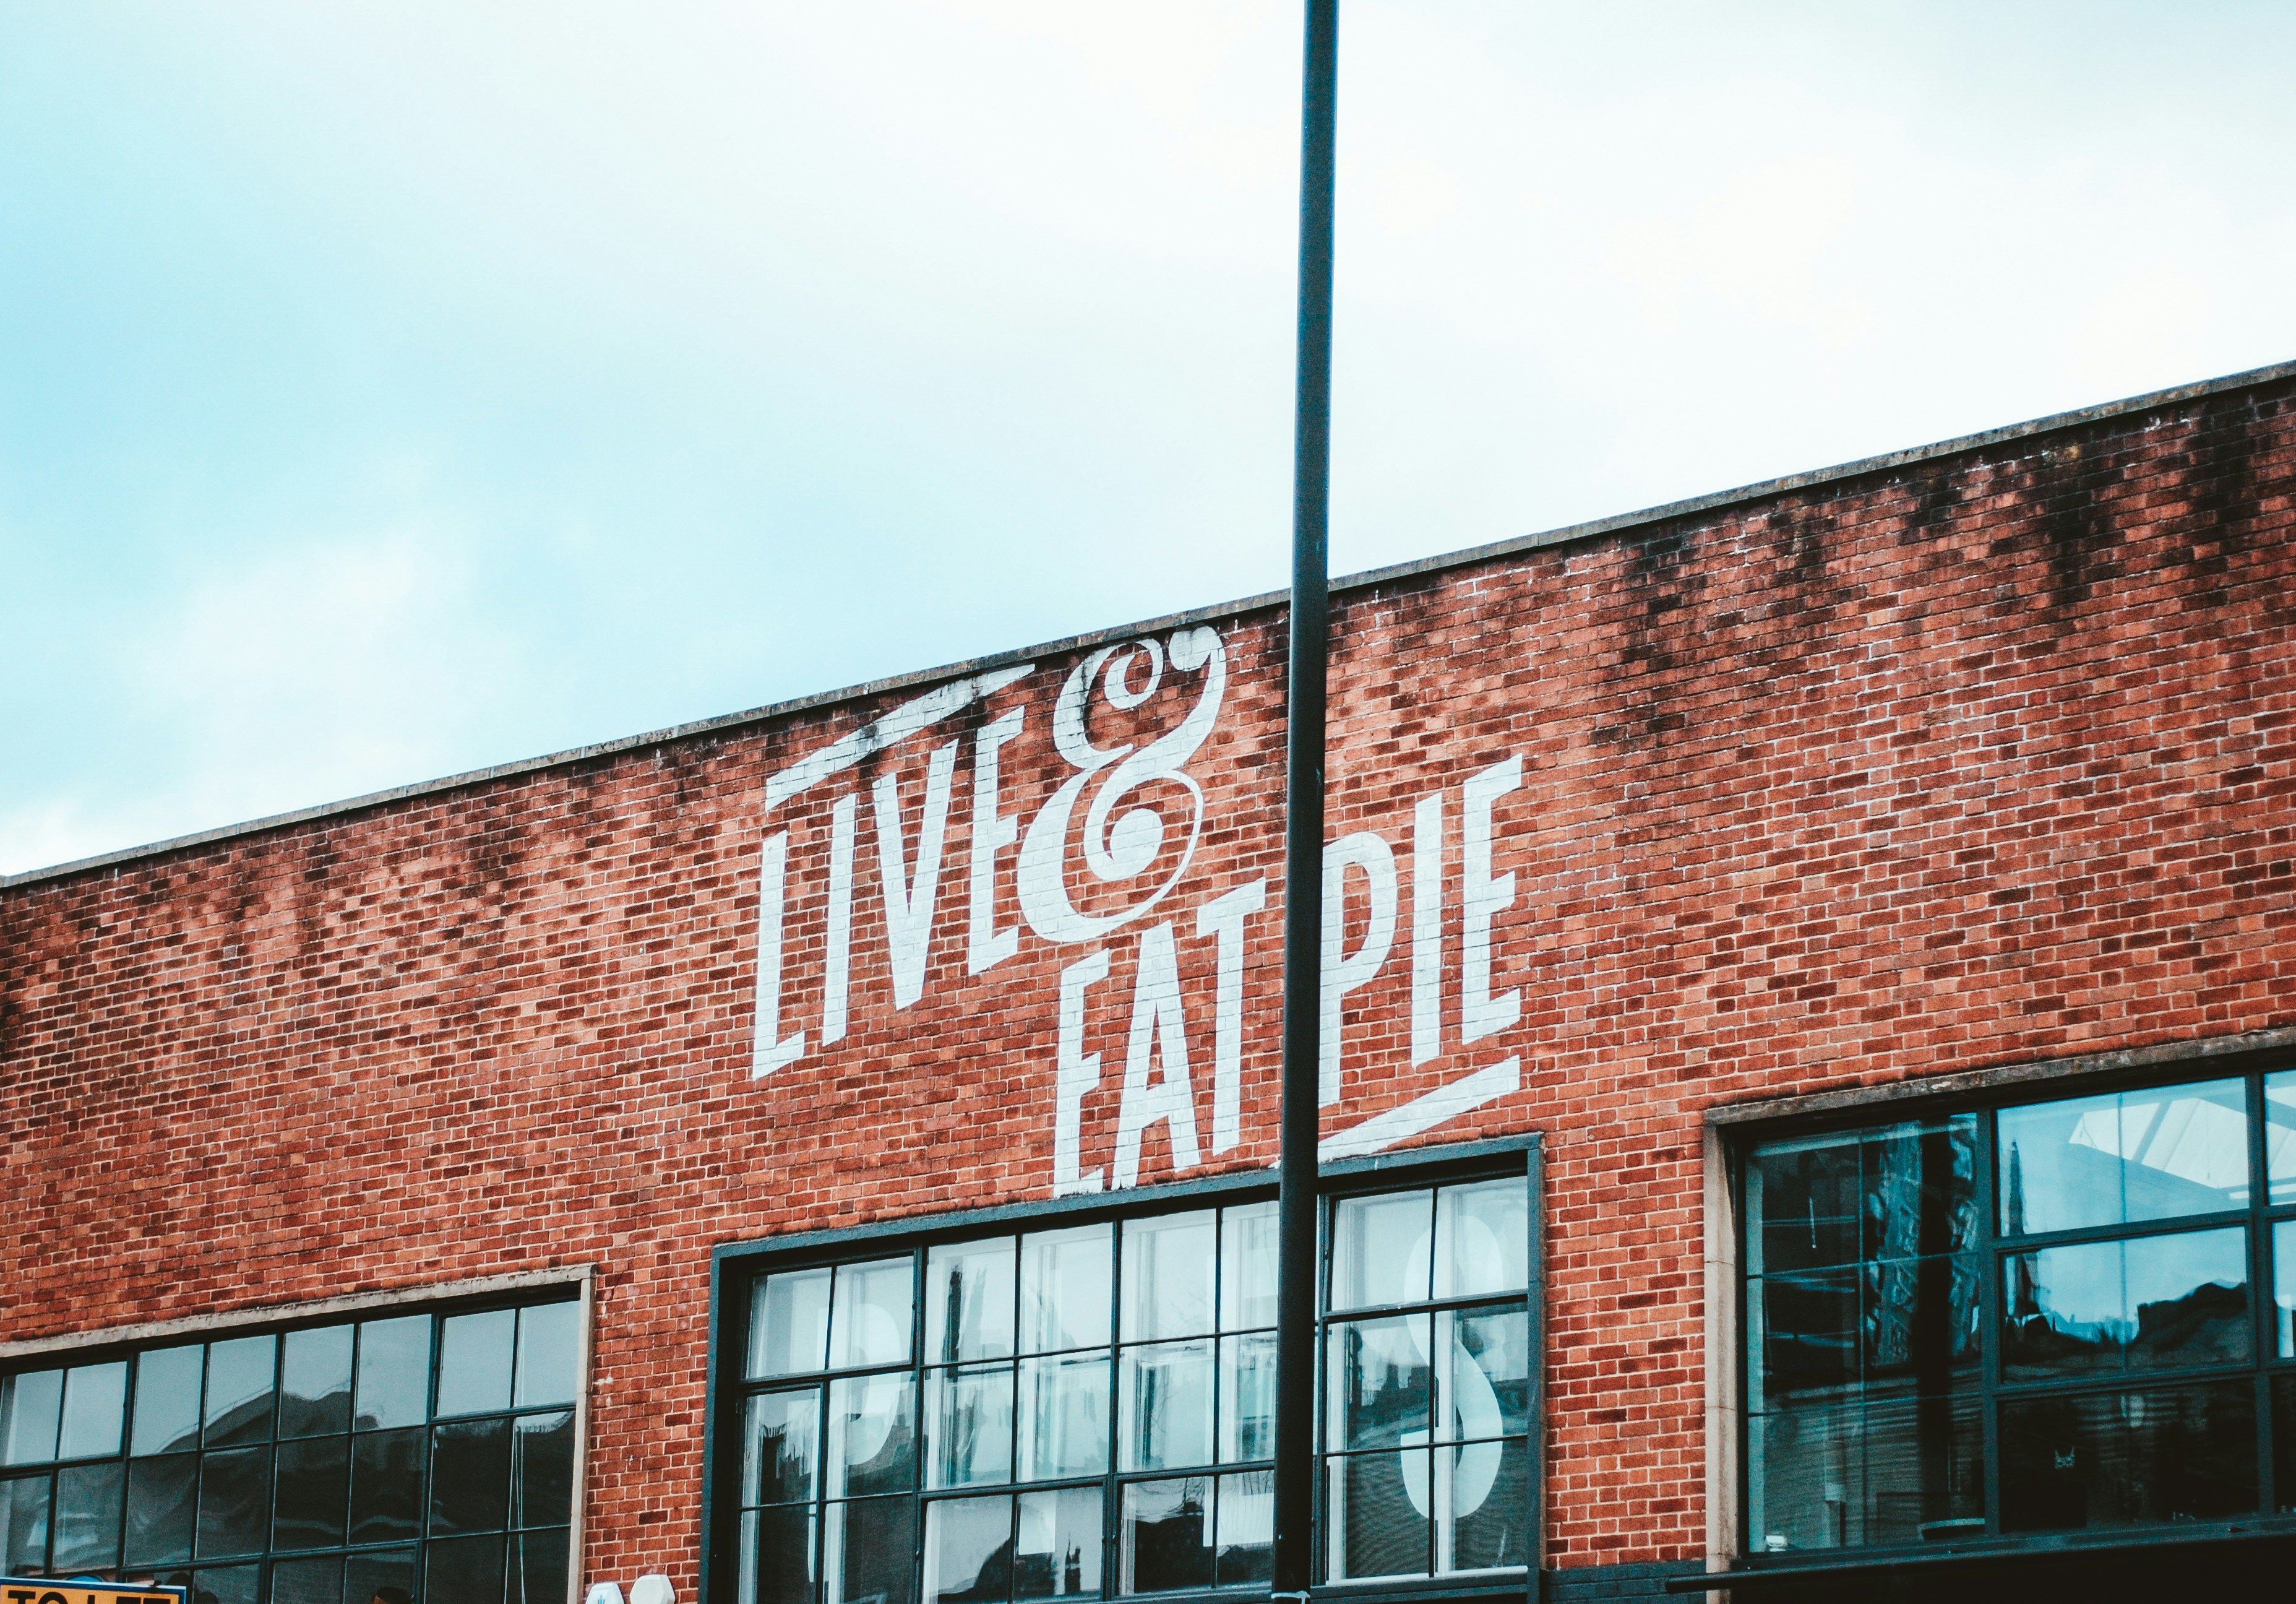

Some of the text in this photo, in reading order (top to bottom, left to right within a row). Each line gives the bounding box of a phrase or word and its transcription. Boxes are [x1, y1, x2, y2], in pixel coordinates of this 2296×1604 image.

[752, 624, 1228, 1081] LIVE &
[1053, 752, 1523, 1199] EAT PIE
